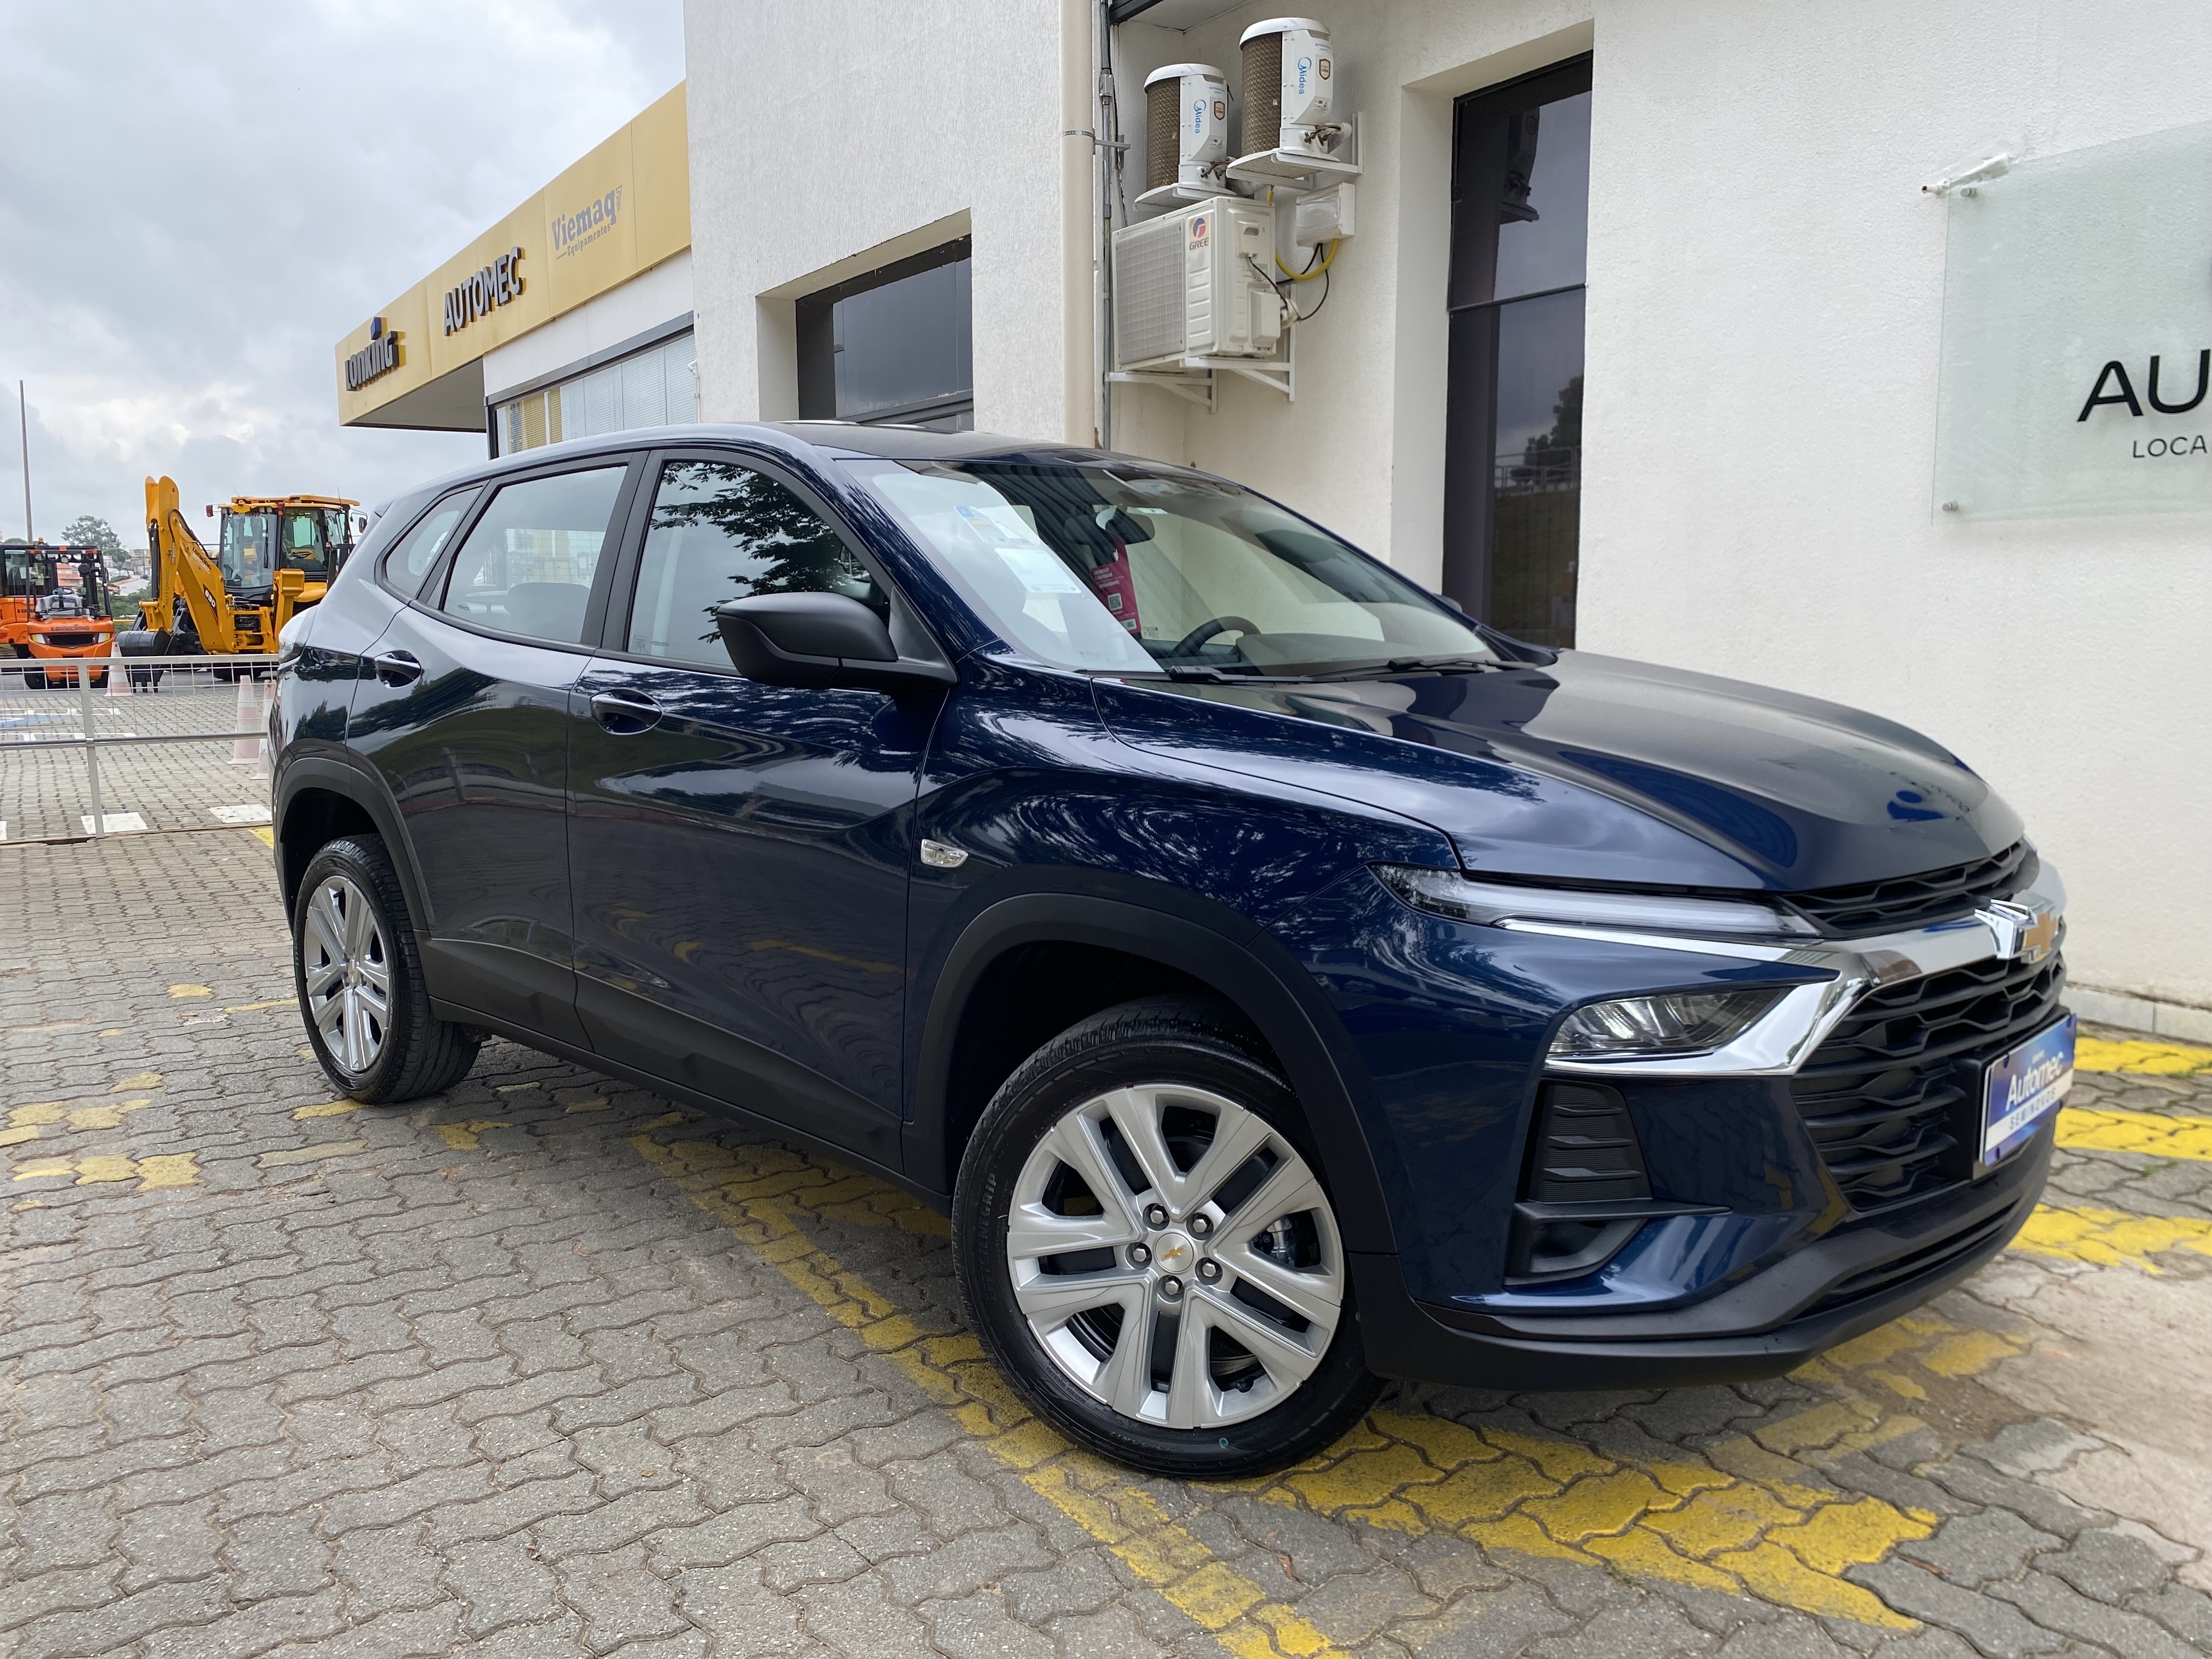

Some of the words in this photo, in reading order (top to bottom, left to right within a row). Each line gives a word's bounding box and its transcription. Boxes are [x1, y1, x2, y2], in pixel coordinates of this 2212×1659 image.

[1298, 57, 1312, 94] Midea
[1194, 99, 1206, 134] Midea
[551, 189, 617, 251] Viemaq
[567, 223, 611, 257] Equipamentos
[1189, 237, 1209, 250] GREE
[444, 246, 524, 337] AUTOMEC
[2076, 348, 2210, 422] AU
[2132, 434, 2212, 458] LOCA
[2005, 1052, 2064, 1111] Automec
